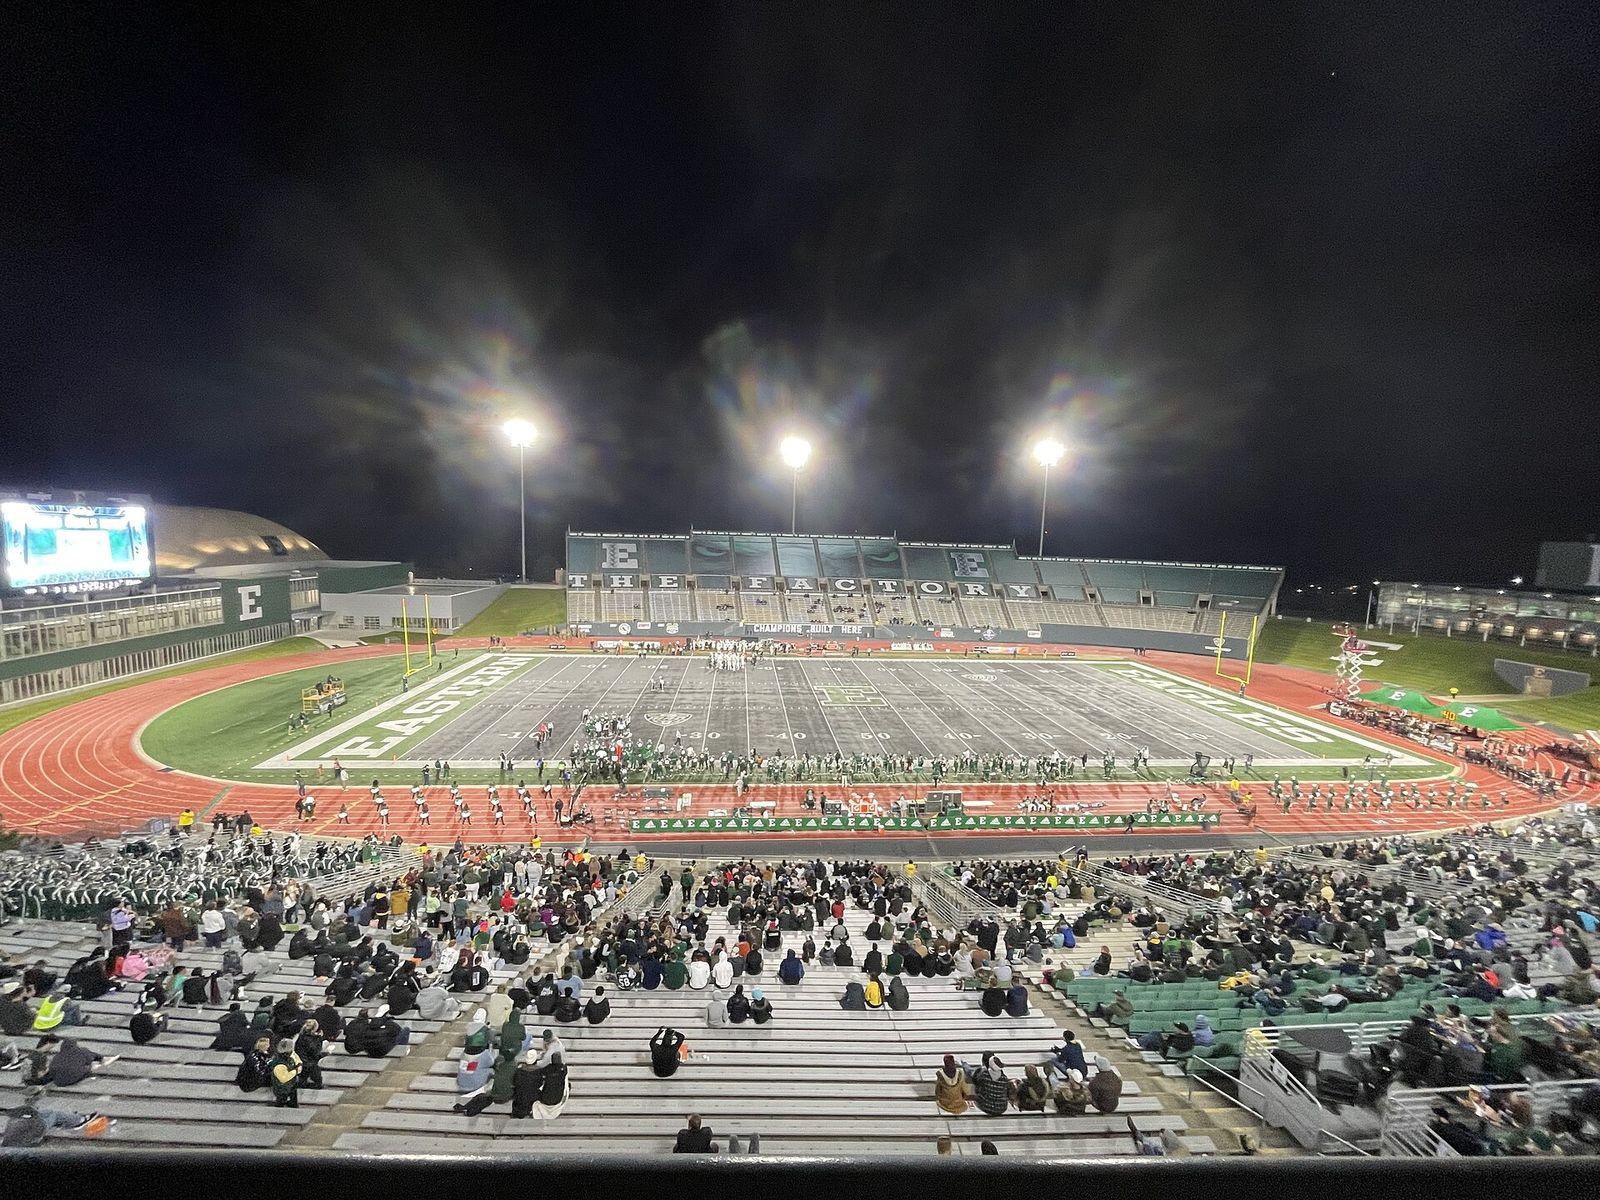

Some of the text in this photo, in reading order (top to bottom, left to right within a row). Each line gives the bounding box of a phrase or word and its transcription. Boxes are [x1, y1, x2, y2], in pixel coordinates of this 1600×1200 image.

[602, 543, 638, 568] E
[950, 552, 990, 577] E
[569, 575, 1032, 597] THE FACTORY
[238, 585, 263, 621] E
[753, 624, 863, 634] CHAMPIONS BUILT HERE
[813, 685, 889, 707] E
[320, 656, 535, 758] EASTERN
[1109, 668, 1335, 743] EAGLES
[1442, 710, 1456, 721] 40
[689, 731, 721, 739] 30
[860, 732, 891, 740] 50
[943, 732, 973, 740] 40
[1021, 732, 1054, 740] 30
[1100, 732, 1133, 740] 20
[1174, 732, 1208, 740] 10
[632, 820, 640, 829] E
[660, 820, 668, 828] E
[687, 820, 696, 828] E
[714, 820, 723, 828] E
[741, 819, 749, 827] E
[768, 818, 776, 827] E
[795, 819, 803, 827] E
[821, 817, 828, 825] E
[848, 818, 856, 826] E
[900, 818, 908, 827] E
[930, 819, 938, 827] E
[955, 817, 962, 826] E
[980, 816, 987, 825] E
[1004, 816, 1012, 825] E
[1029, 816, 1037, 825] E
[1054, 816, 1062, 825] E
[1079, 816, 1086, 824] E
[1103, 816, 1111, 824] E
[1150, 814, 1158, 823] E
[1175, 814, 1182, 823] E
[618, 974, 631, 987] 58
